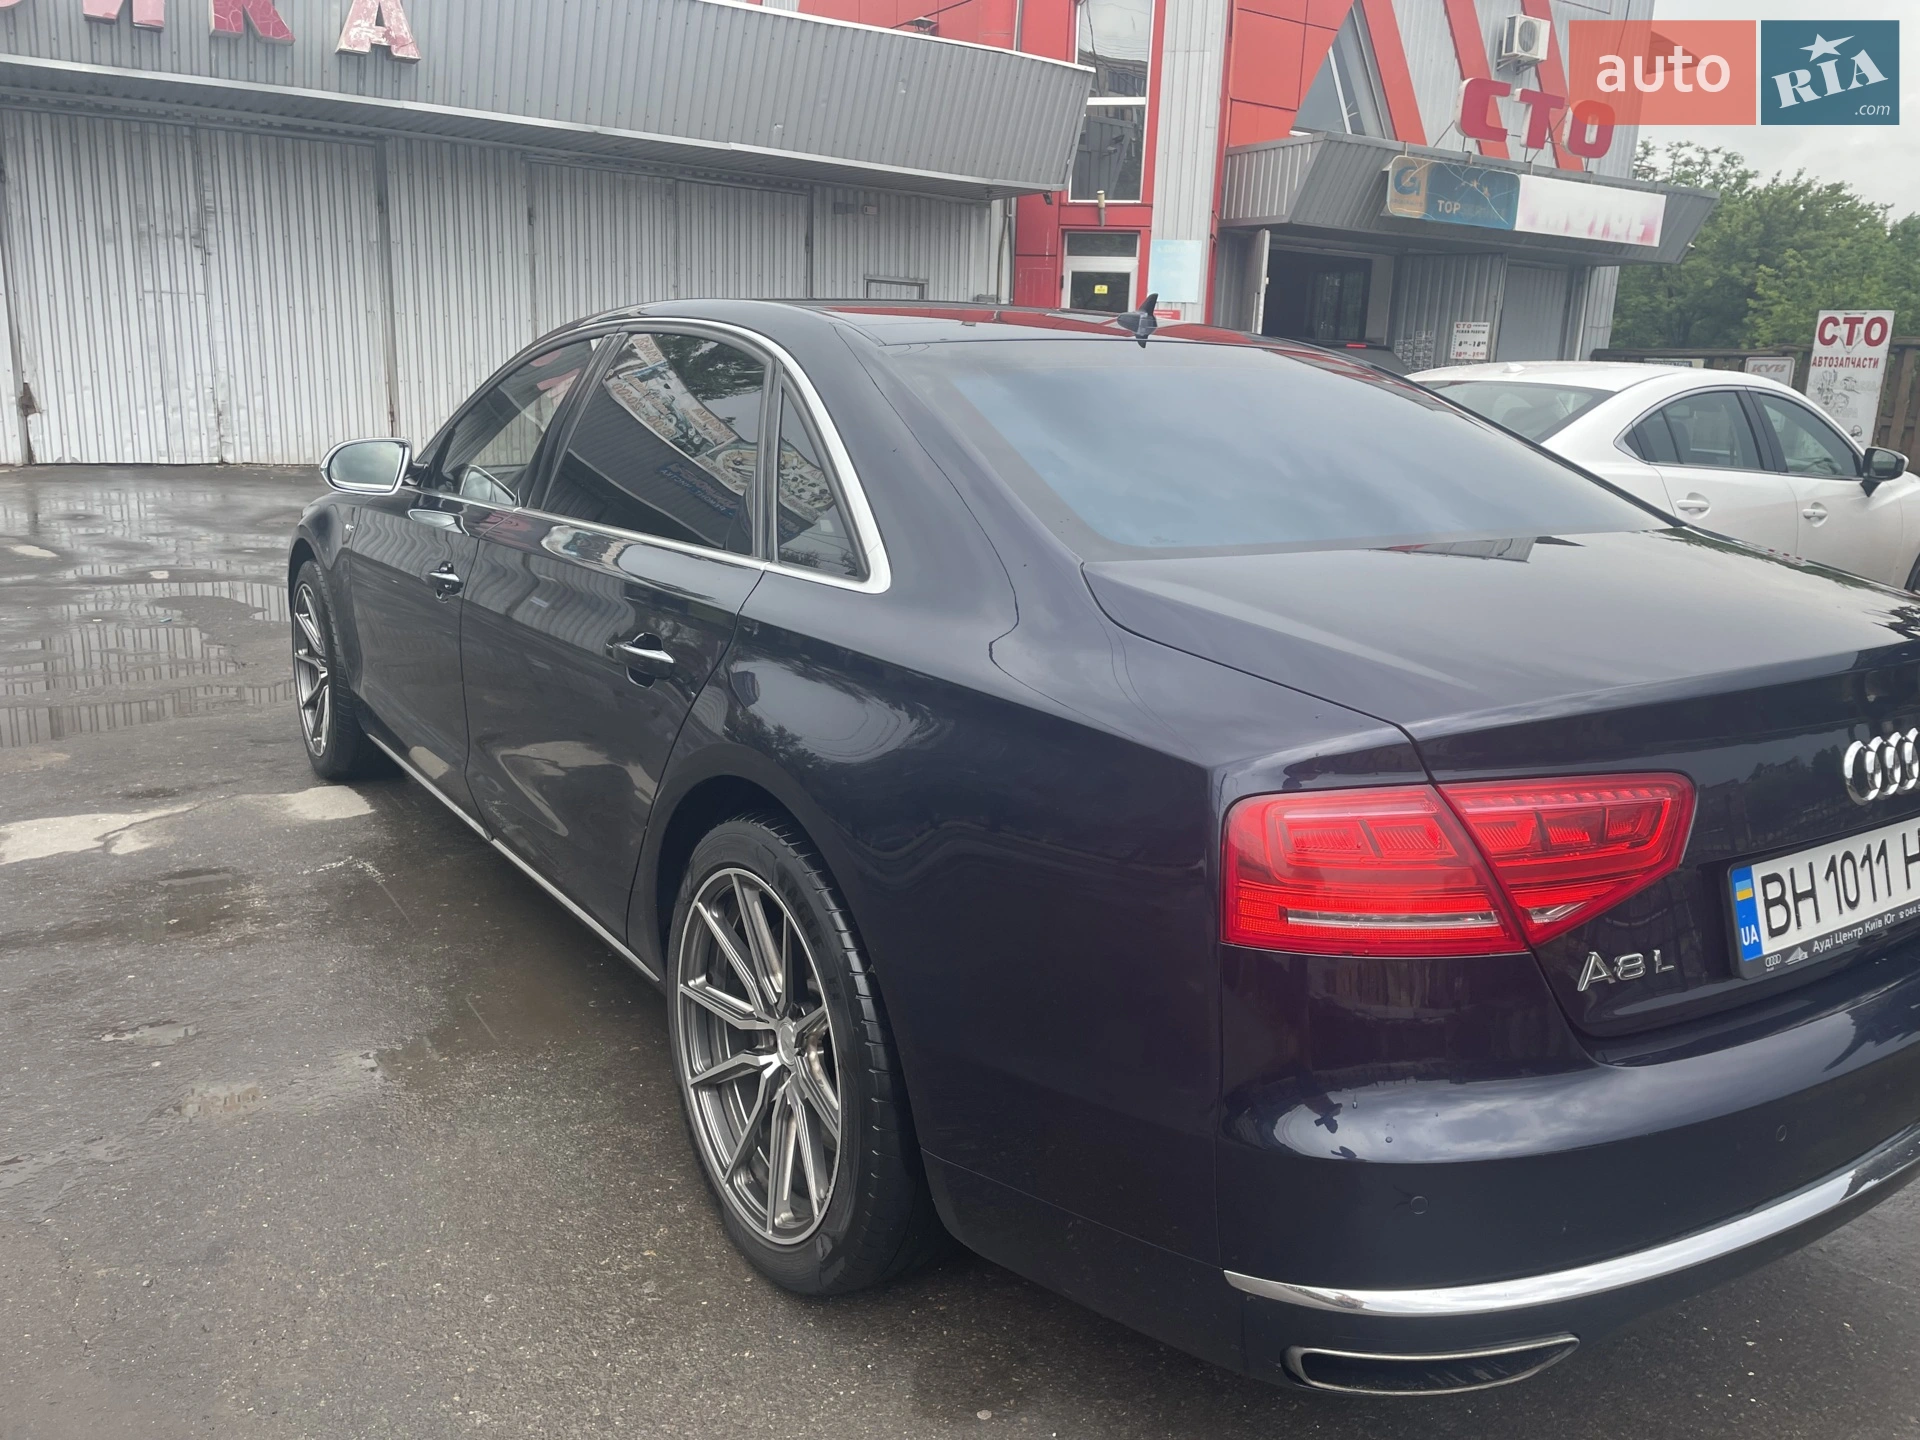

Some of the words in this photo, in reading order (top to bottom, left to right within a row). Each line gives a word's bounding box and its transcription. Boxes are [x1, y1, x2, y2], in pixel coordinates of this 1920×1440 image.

[1457, 77, 1616, 159] СТО
[1437, 199, 1460, 215] TOP
[1817, 316, 1889, 347] СТО
[1751, 364, 1787, 374] KYB
[1811, 356, 1879, 369] АВТОЗАПЧАСТИ
[1761, 861, 1821, 939] BH
[1825, 838, 1893, 916] 1011
[1741, 924, 1759, 946] UA
[1812, 935, 1834, 953] Ауді
[1835, 926, 1863, 945] Центр
[1865, 917, 1883, 934] Київ
[1884, 912, 1896, 926] Юг
[1577, 951, 1646, 992] A8
[1652, 949, 1675, 974] L
